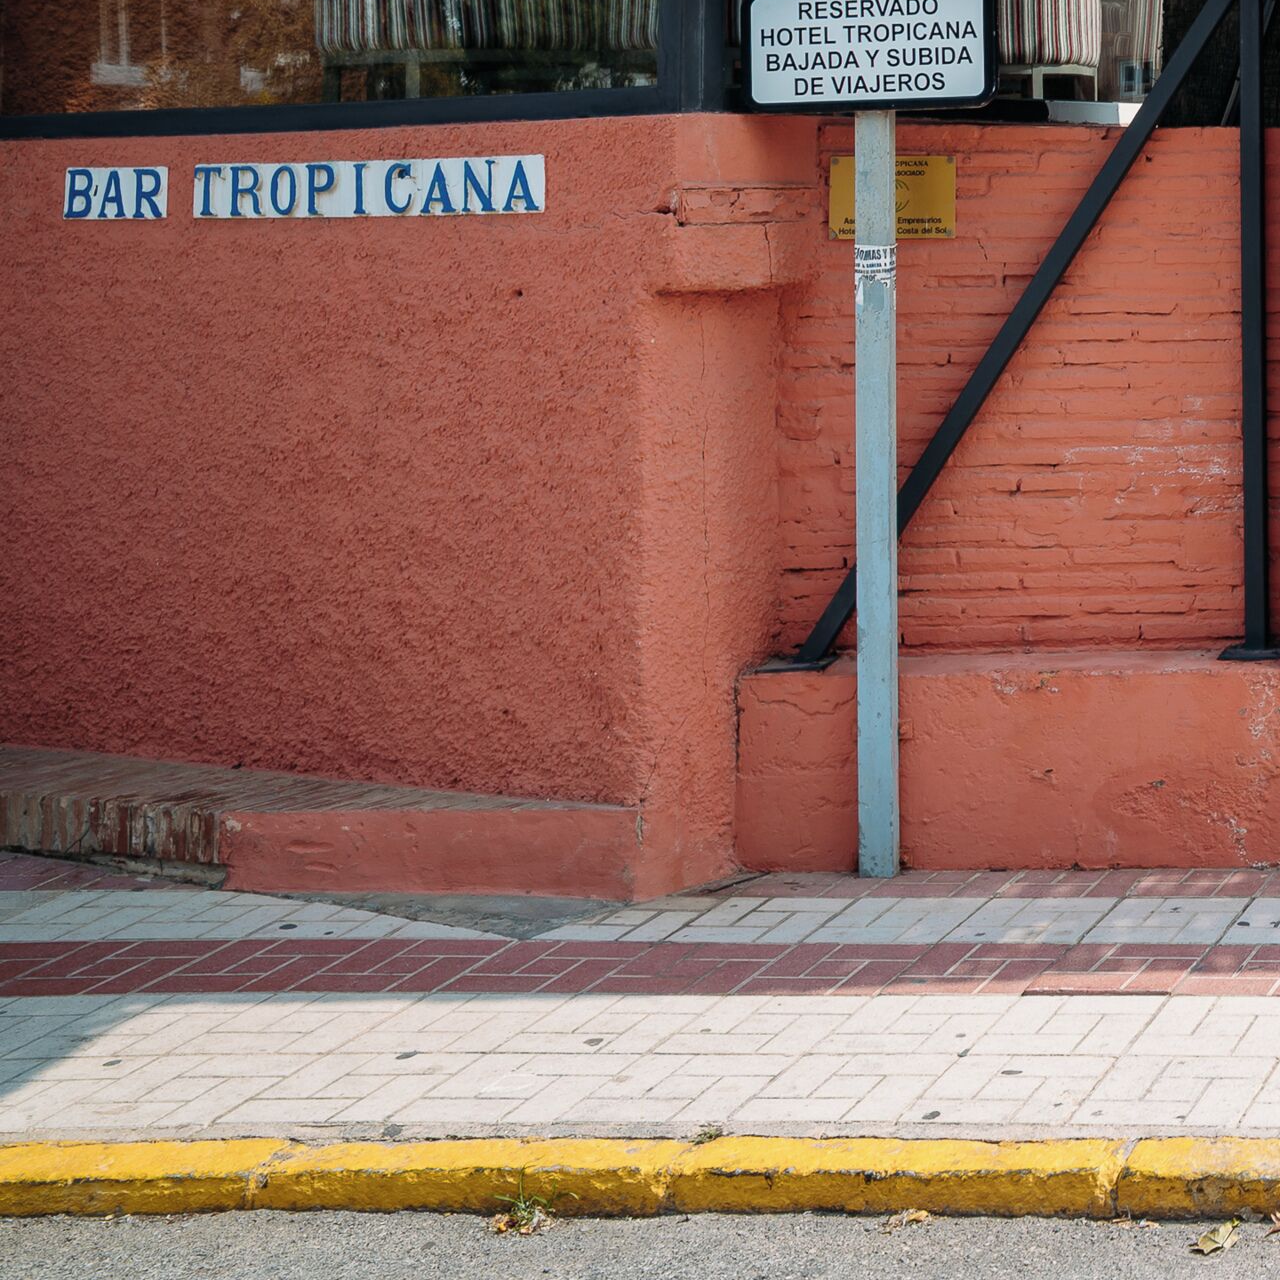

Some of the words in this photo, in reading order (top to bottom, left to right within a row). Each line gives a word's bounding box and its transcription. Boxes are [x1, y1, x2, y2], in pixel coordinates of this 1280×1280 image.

[760, 26, 837, 47] HOTEL
[843, 20, 978, 44] TROPICANA
[765, 49, 861, 72] BAJADA
[865, 49, 880, 68] Y
[886, 46, 974, 67] SUBIDA
[794, 76, 825, 97] DE
[831, 72, 946, 96] VIAJEROS
[63, 168, 163, 219] BAR
[194, 159, 541, 217] TROPICANA
[897, 216, 942, 225] Empresarios
[921, 226, 932, 234] del
[935, 226, 947, 234] Sol
